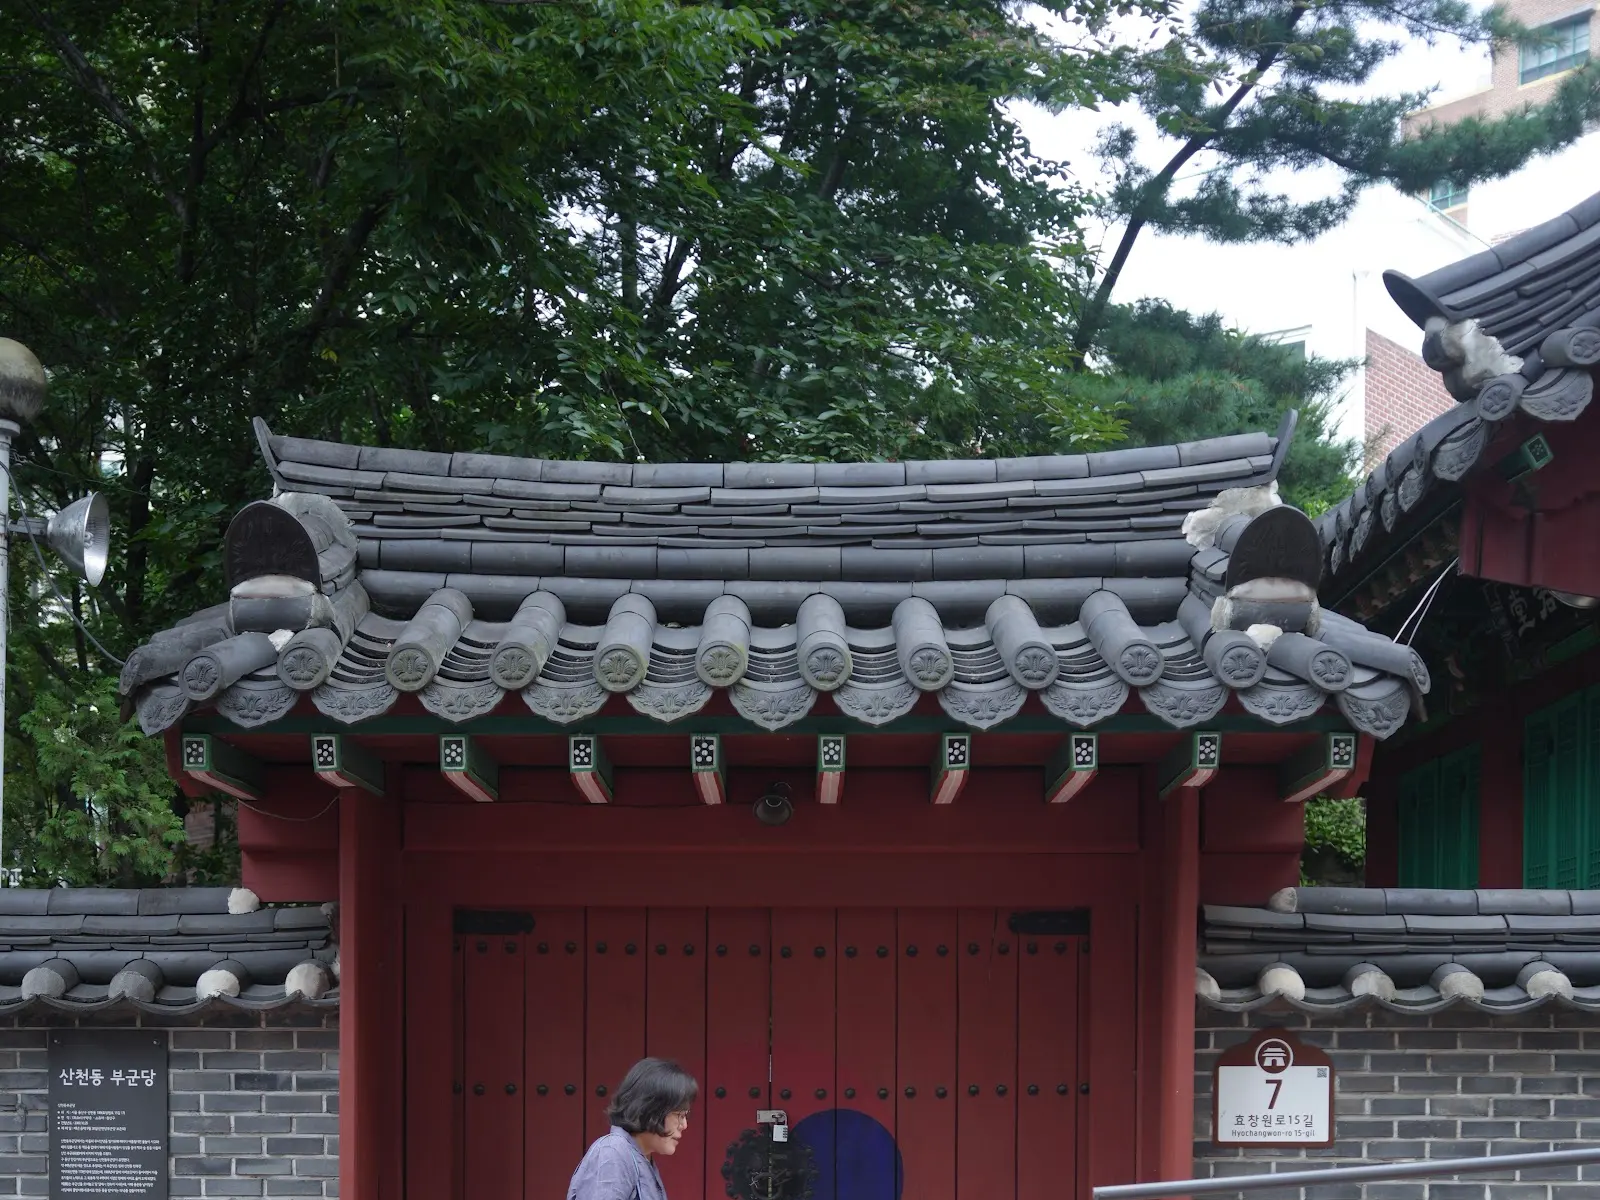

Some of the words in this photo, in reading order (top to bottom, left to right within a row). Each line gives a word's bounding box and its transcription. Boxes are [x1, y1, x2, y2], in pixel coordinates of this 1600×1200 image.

[59, 1068, 104, 1087] 산천동
[110, 1068, 156, 1087] 부군당
[1265, 1079, 1282, 1109] 7
[1234, 1114, 1313, 1127] 효창원로15길
[1232, 1129, 1293, 1138] Hyochangwon-ro
[1294, 1129, 1315, 1138] 15-gil
